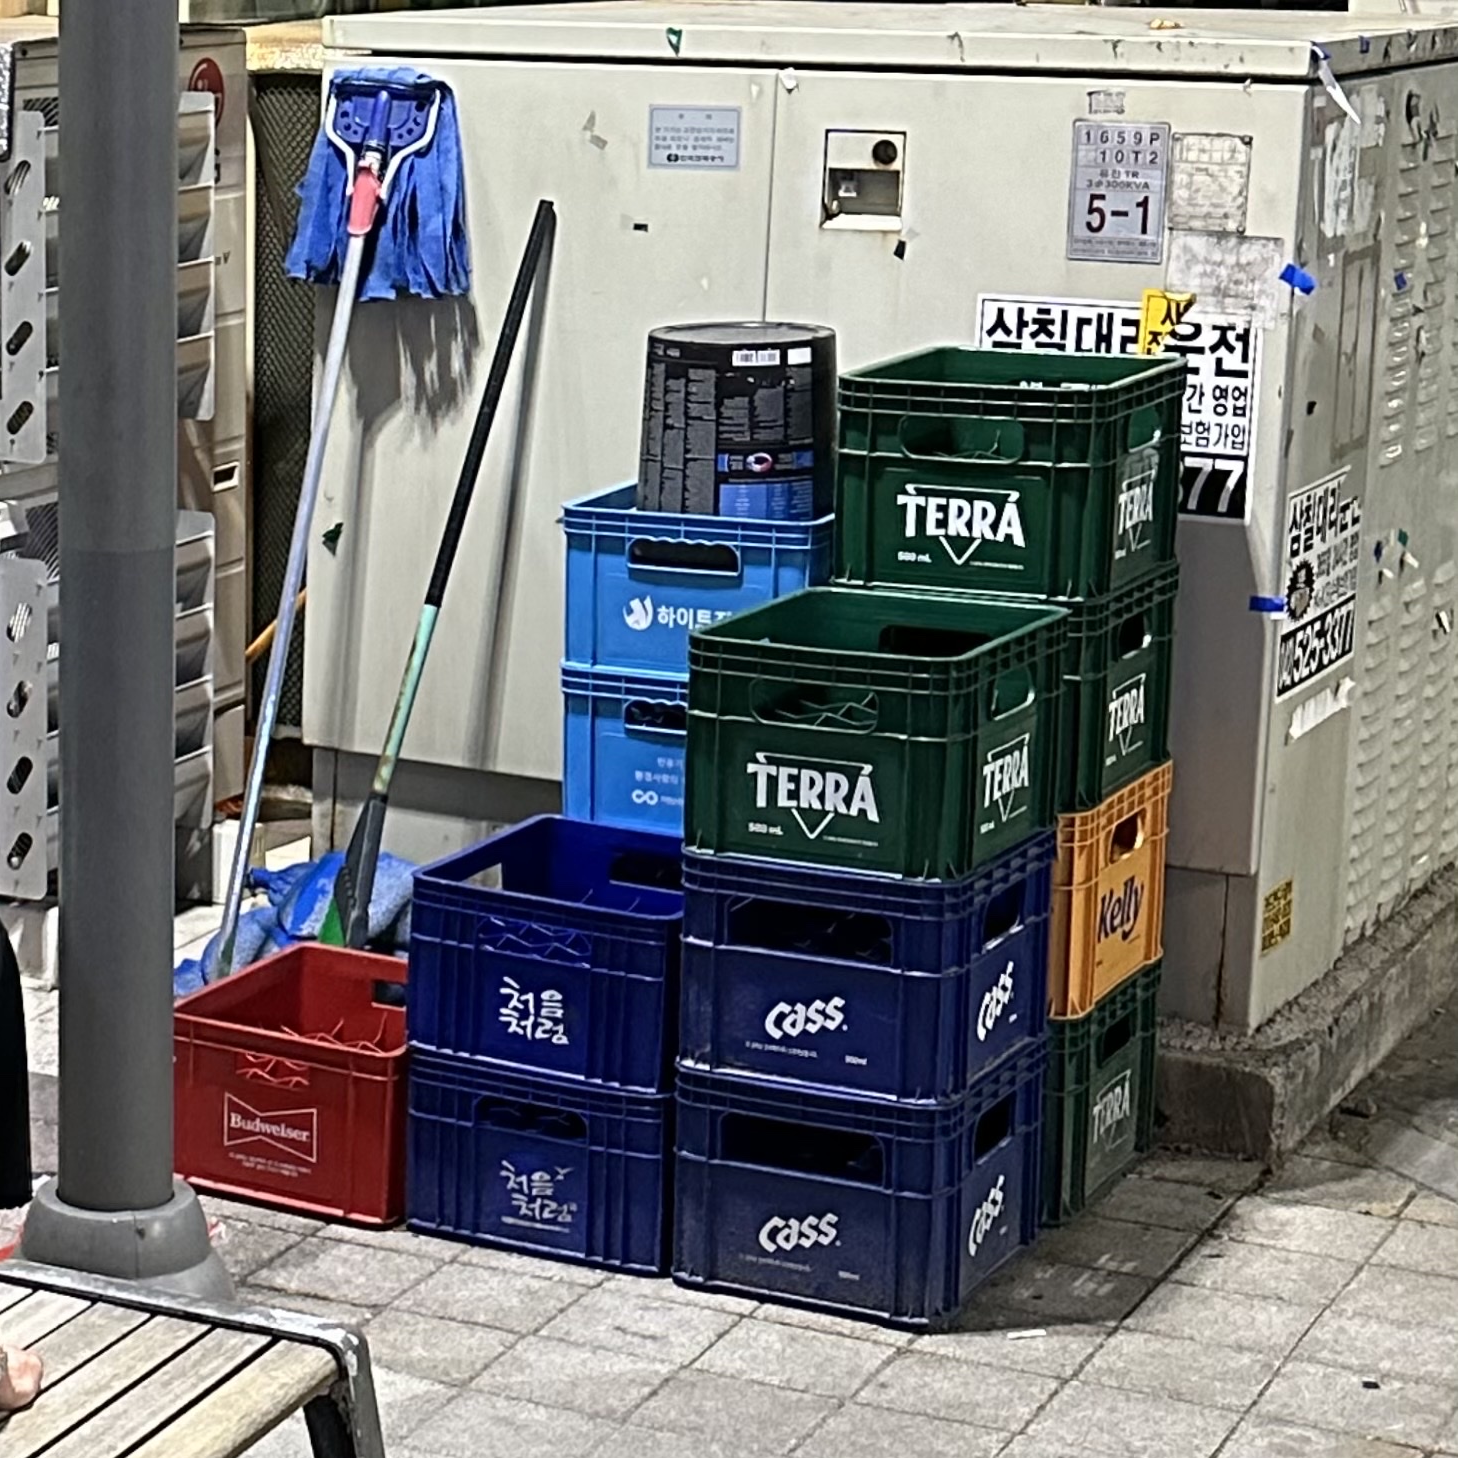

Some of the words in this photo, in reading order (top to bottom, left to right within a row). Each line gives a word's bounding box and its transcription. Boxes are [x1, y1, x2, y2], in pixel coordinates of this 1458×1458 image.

[1085, 193, 1149, 235] 5-1
[986, 306, 1250, 379] 삼칠대운전
[1212, 385, 1248, 418] 영업
[1181, 421, 1246, 450] 보험가입
[1118, 481, 1154, 535] TERRA
[1179, 458, 1245, 513] 77
[897, 494, 1026, 548] TERRA
[1109, 684, 1145, 742] TERRA
[747, 763, 880, 823] TERRA
[983, 745, 1029, 808] TERRA
[1097, 875, 1145, 943] Kelly
[499, 976, 564, 1019] 처음
[229, 1112, 311, 1142] Budweiser
[1093, 1080, 1131, 1144] TERRA
[500, 1160, 554, 1196] 처음
